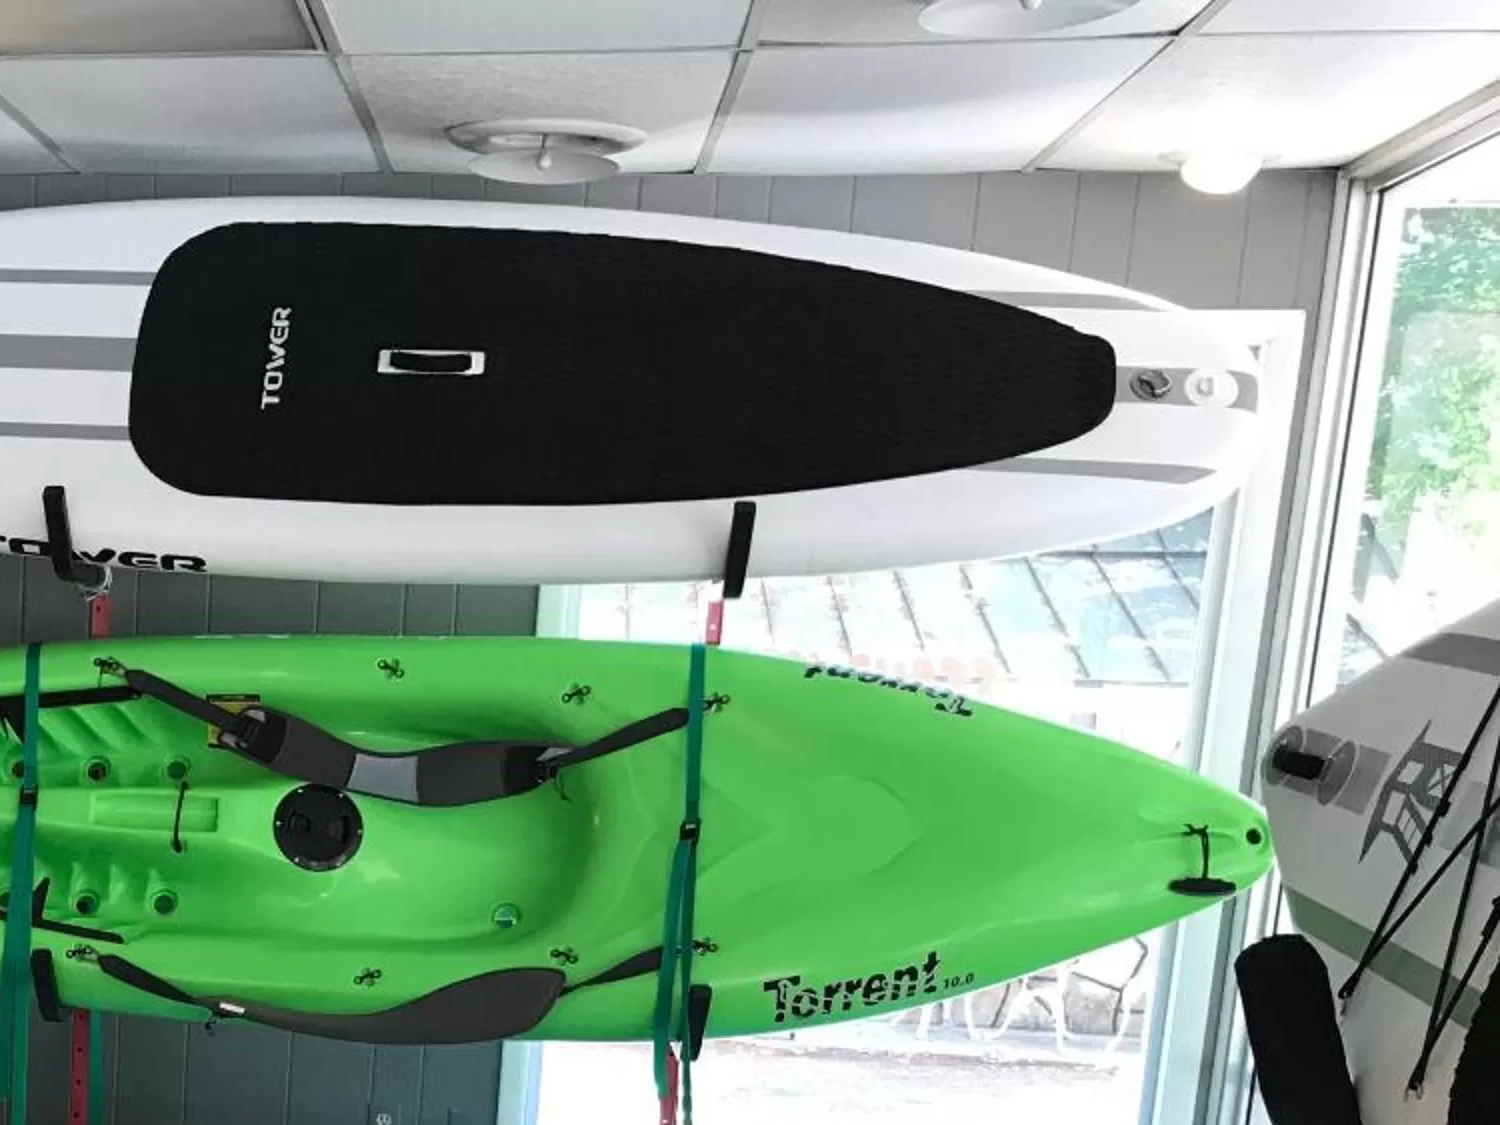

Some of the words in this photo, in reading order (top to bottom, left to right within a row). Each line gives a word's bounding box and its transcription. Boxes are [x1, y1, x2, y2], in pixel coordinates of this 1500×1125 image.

[260, 307, 293, 410] TOWER
[762, 950, 941, 1023] Torrent
[942, 972, 976, 990] 10.0
